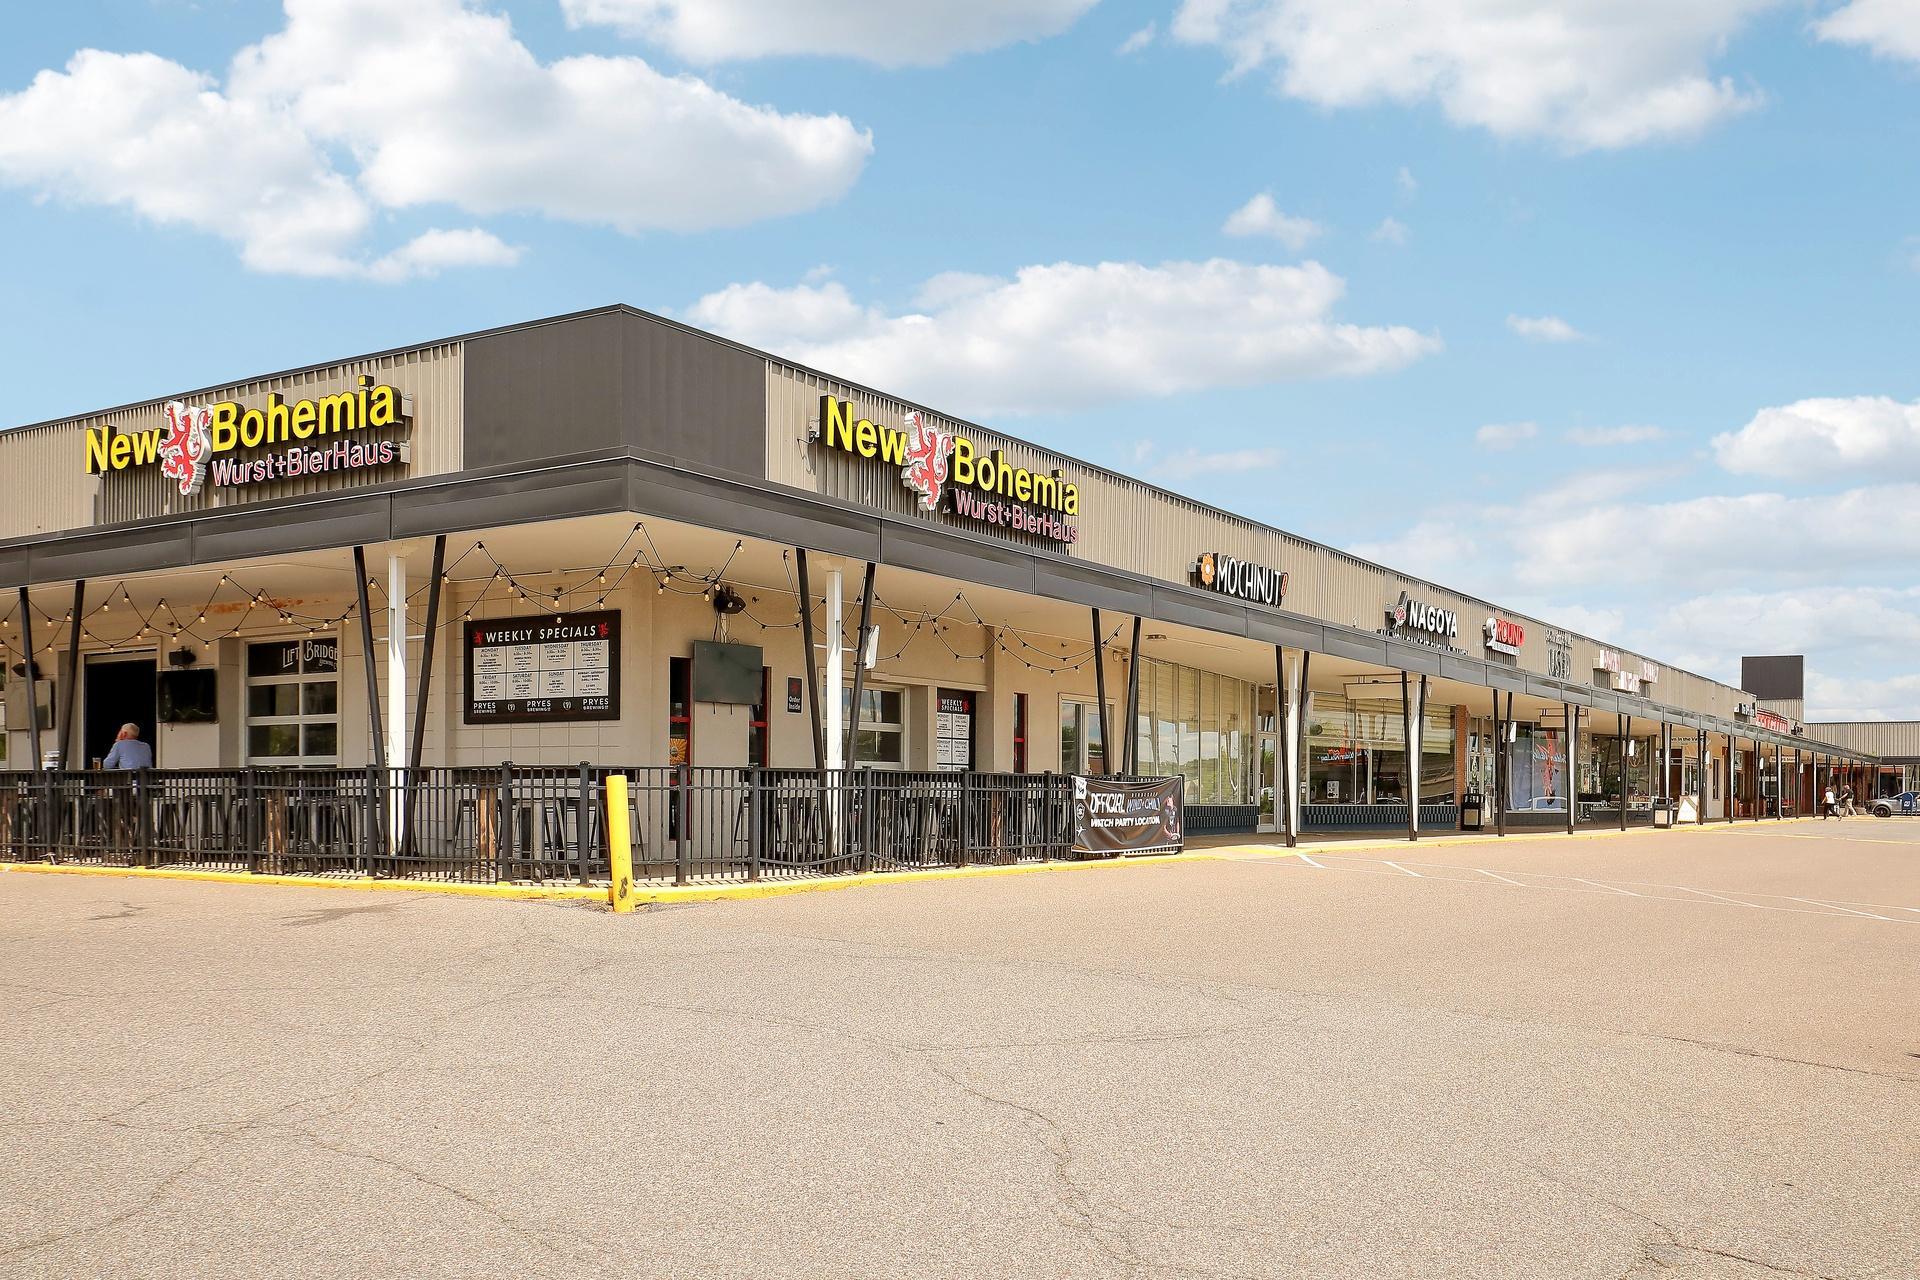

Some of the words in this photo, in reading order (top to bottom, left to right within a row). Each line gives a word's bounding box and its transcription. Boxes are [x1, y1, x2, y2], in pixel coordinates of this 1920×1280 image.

[85, 427, 161, 475] New
[212, 374, 397, 453] Bohemia
[212, 439, 393, 487] Wurst+BierHaus
[826, 395, 907, 466] New
[952, 436, 1080, 517] Bohemia
[954, 487, 1080, 545] Wurst+BierHaus
[1216, 553, 1282, 606] MOCHINUT
[1408, 600, 1458, 639] NAGOYA
[485, 629, 533, 643] WEEKLY
[539, 625, 596, 640] SPECIALS
[473, 702, 496, 710] PRYES
[527, 699, 551, 708] PRYES
[582, 697, 609, 706] PRYES
[941, 698, 963, 706] WEEKLY
[941, 704, 963, 712] SPECIALS
[1090, 793, 1125, 814] OFFICIAL
[1090, 818, 1114, 828] WATCH
[1115, 817, 1134, 828] PARTY
[1135, 815, 1160, 826] LOCATION
